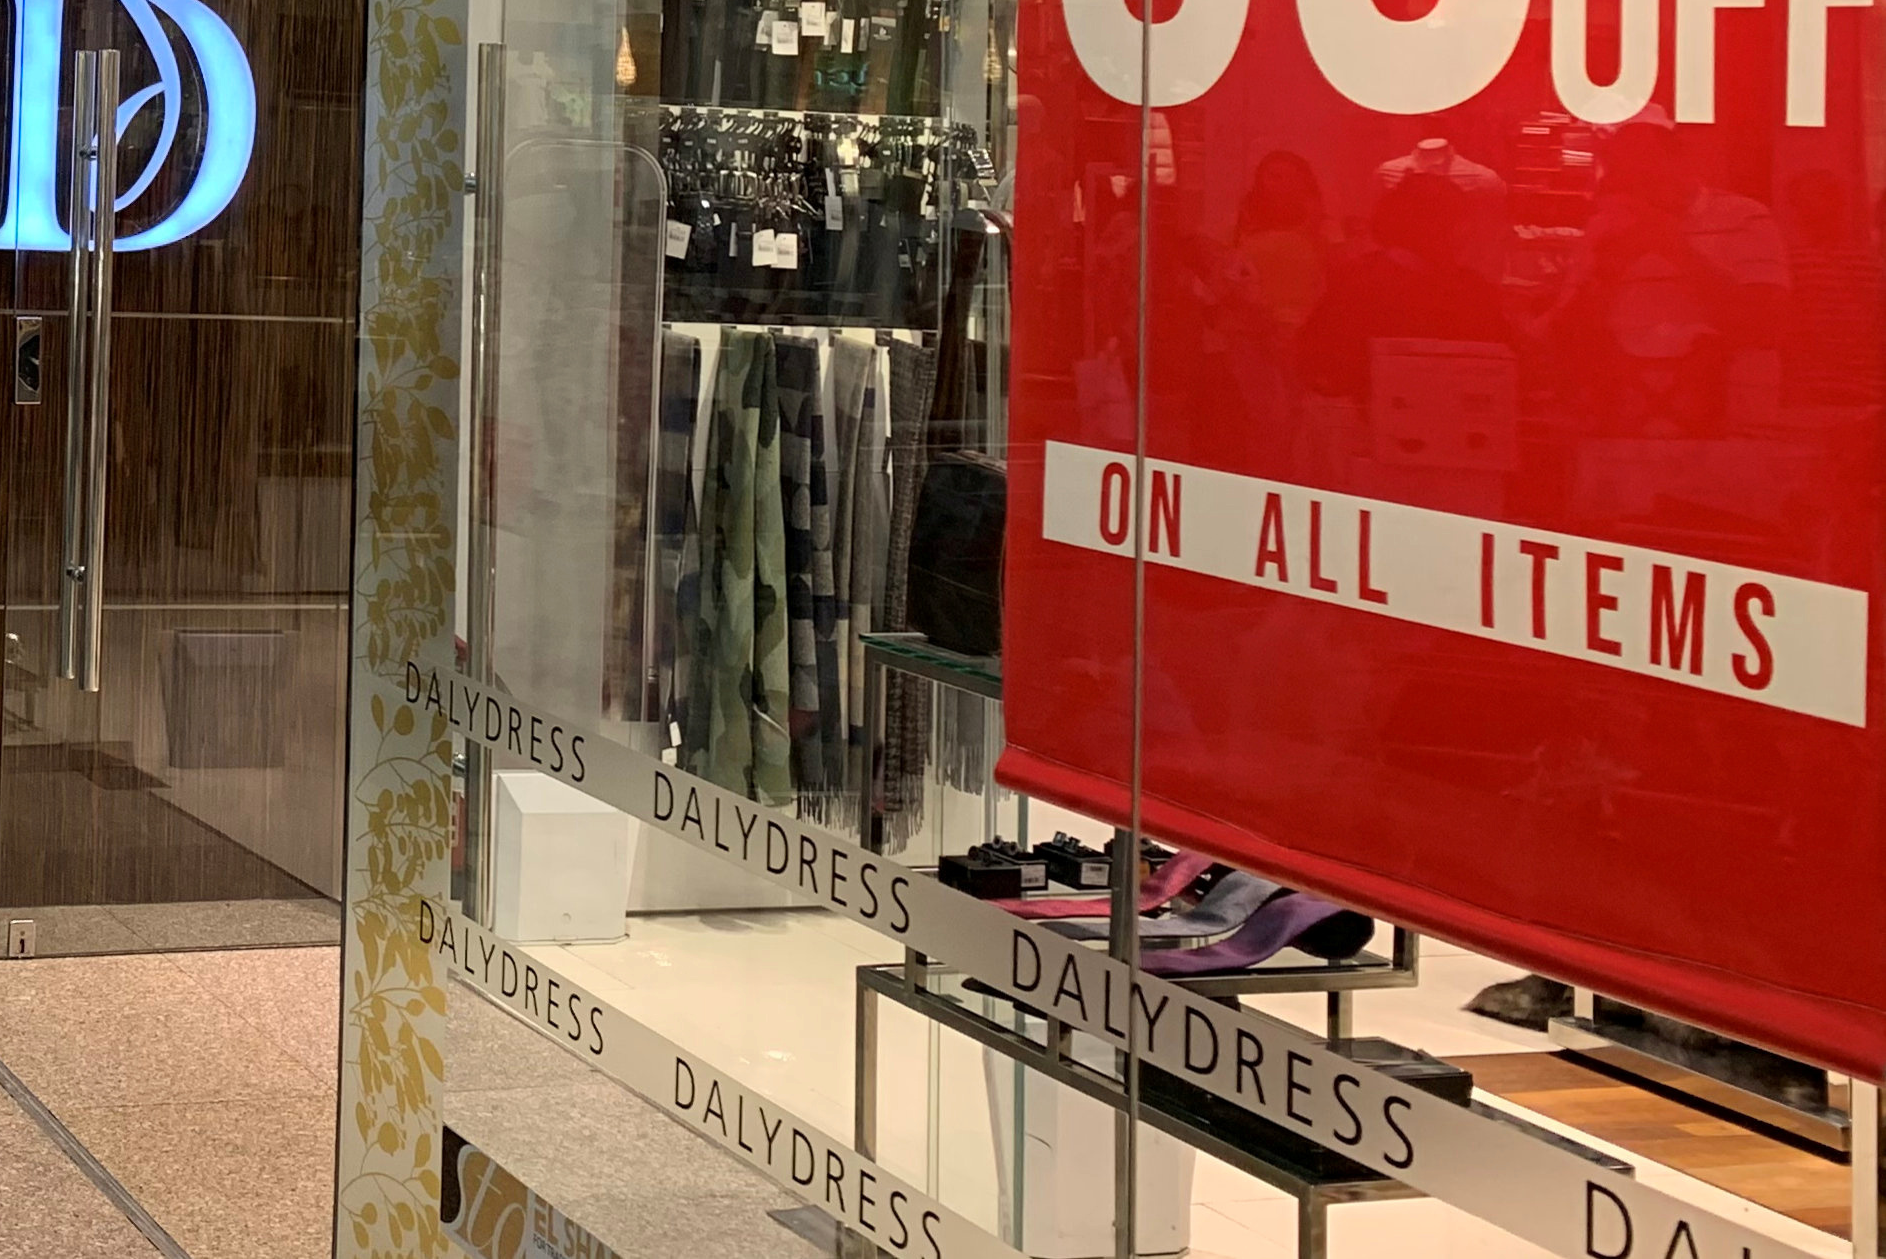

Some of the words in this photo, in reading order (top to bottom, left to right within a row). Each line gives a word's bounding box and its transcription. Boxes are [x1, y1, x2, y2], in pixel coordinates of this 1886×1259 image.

[1098, 460, 1183, 558] ON
[1254, 492, 1389, 605] ALL
[1480, 531, 1776, 691] ITEMS
[405, 661, 585, 783] DALYDRESS
[653, 770, 910, 934] DALYDRESS
[1013, 928, 1414, 1170] DALYDRESS
[1586, 1180, 1752, 1259] DA
[419, 899, 604, 1056] DALYDRESS
[674, 1056, 942, 1259] DALYDRESS
